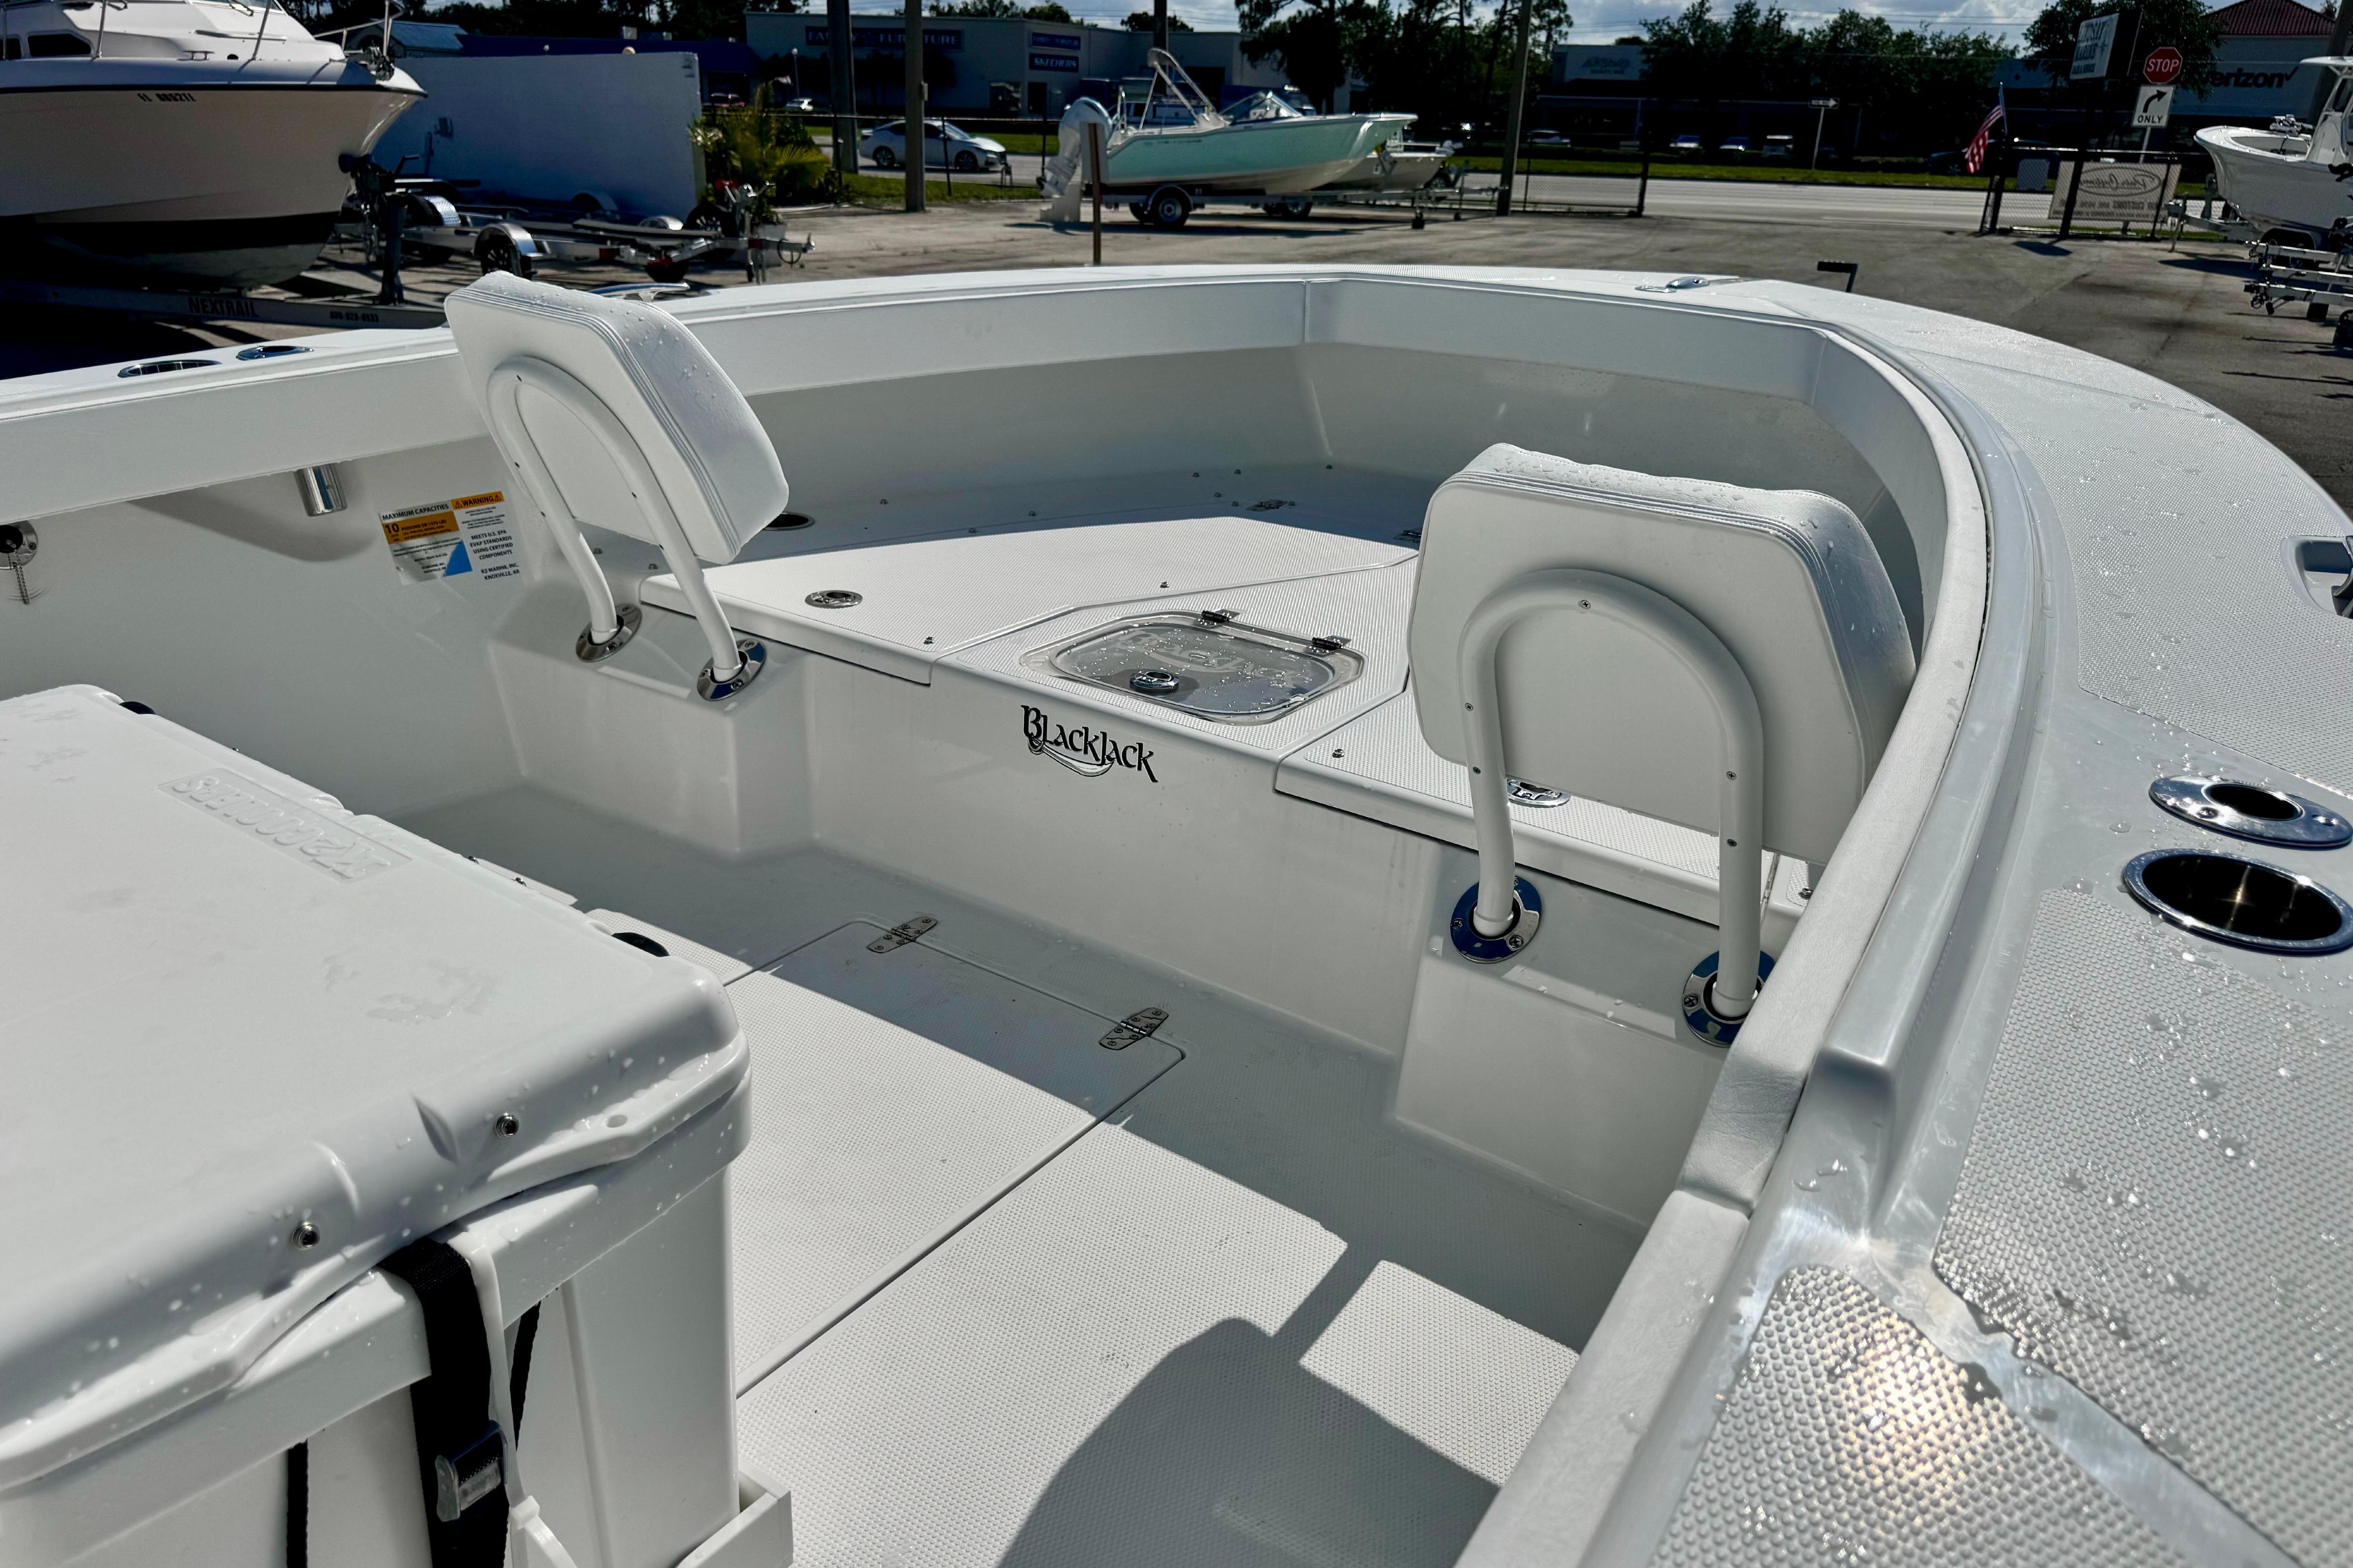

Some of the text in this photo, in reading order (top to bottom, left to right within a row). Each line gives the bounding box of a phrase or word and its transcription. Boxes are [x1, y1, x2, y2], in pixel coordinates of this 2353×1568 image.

[879, 33, 958, 45] FURTURE
[2147, 59, 2180, 73] STOP
[2138, 115, 2163, 124] ONLY
[188, 298, 259, 318] NEXTRAIL
[462, 495, 494, 506] WARNING
[382, 503, 449, 520] MAXIMUM CAPACITIES
[385, 523, 399, 534] 10
[483, 536, 512, 545] STANDARDS
[489, 542, 513, 551] CERTIFIED
[479, 549, 512, 560] COMPONENTS
